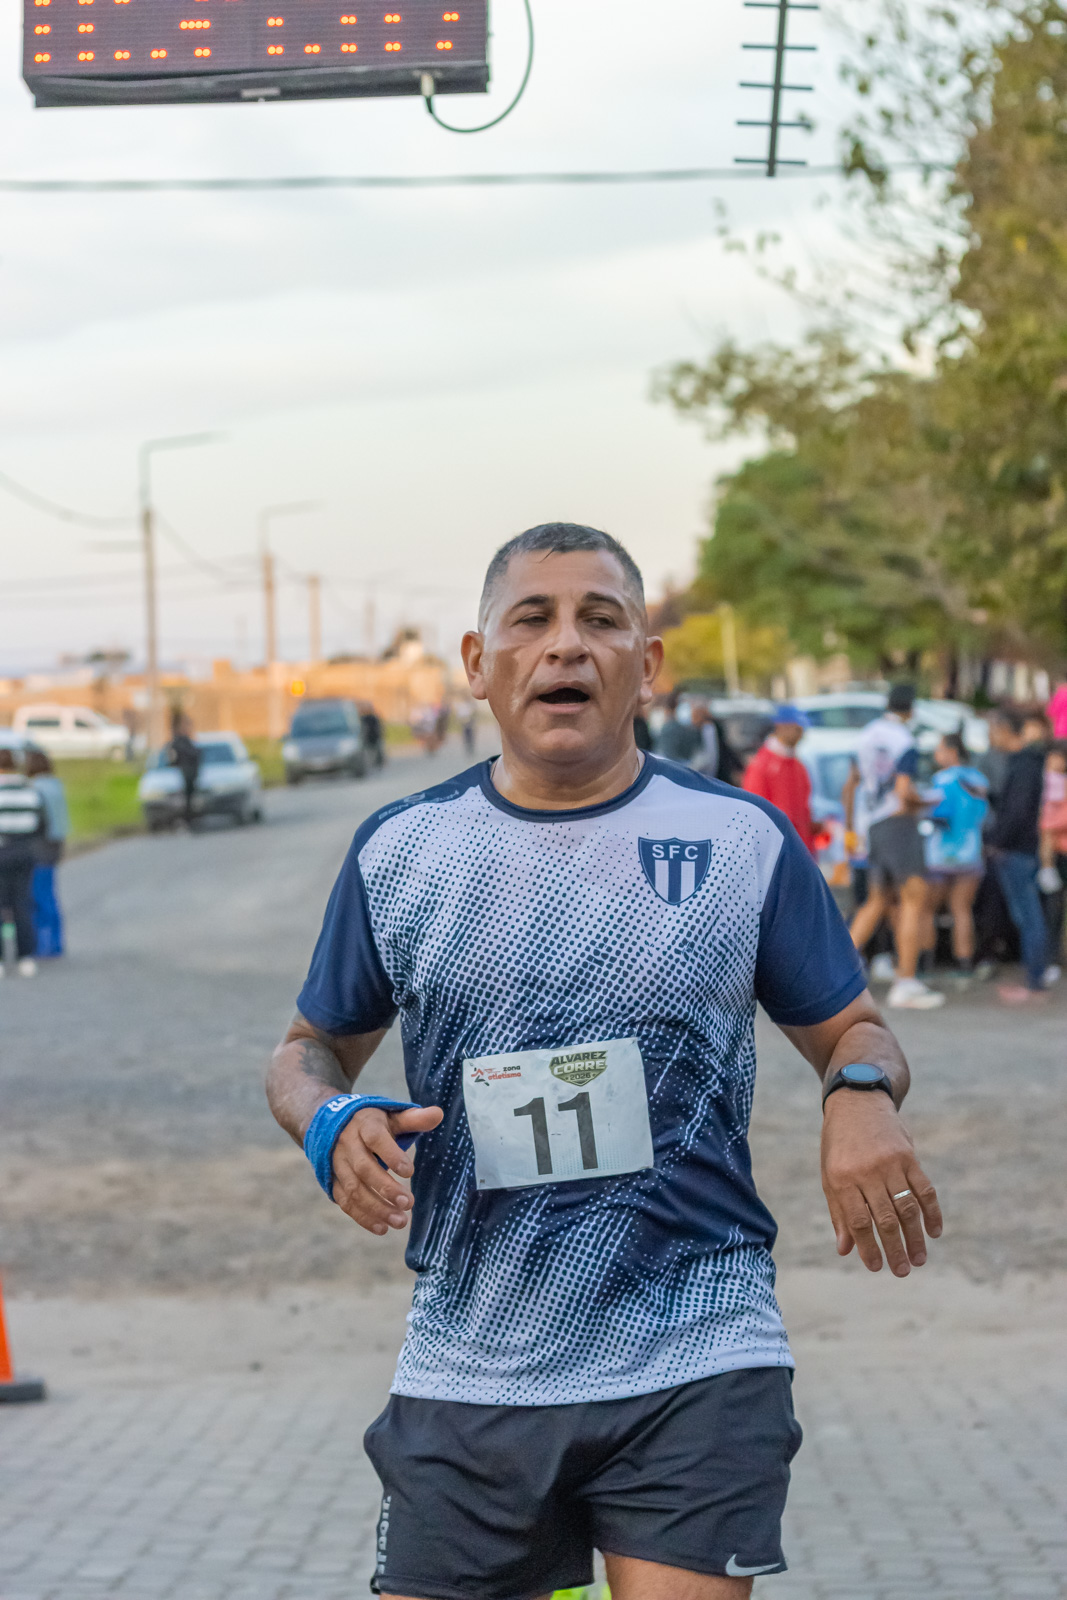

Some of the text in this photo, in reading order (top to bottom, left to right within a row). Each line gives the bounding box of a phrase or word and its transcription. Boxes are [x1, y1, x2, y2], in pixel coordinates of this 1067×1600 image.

[652, 844, 698, 860] SFC
[551, 1051, 607, 1066] ALVAREZ
[553, 1060, 606, 1075] CORRE
[513, 1092, 599, 1176] 11
